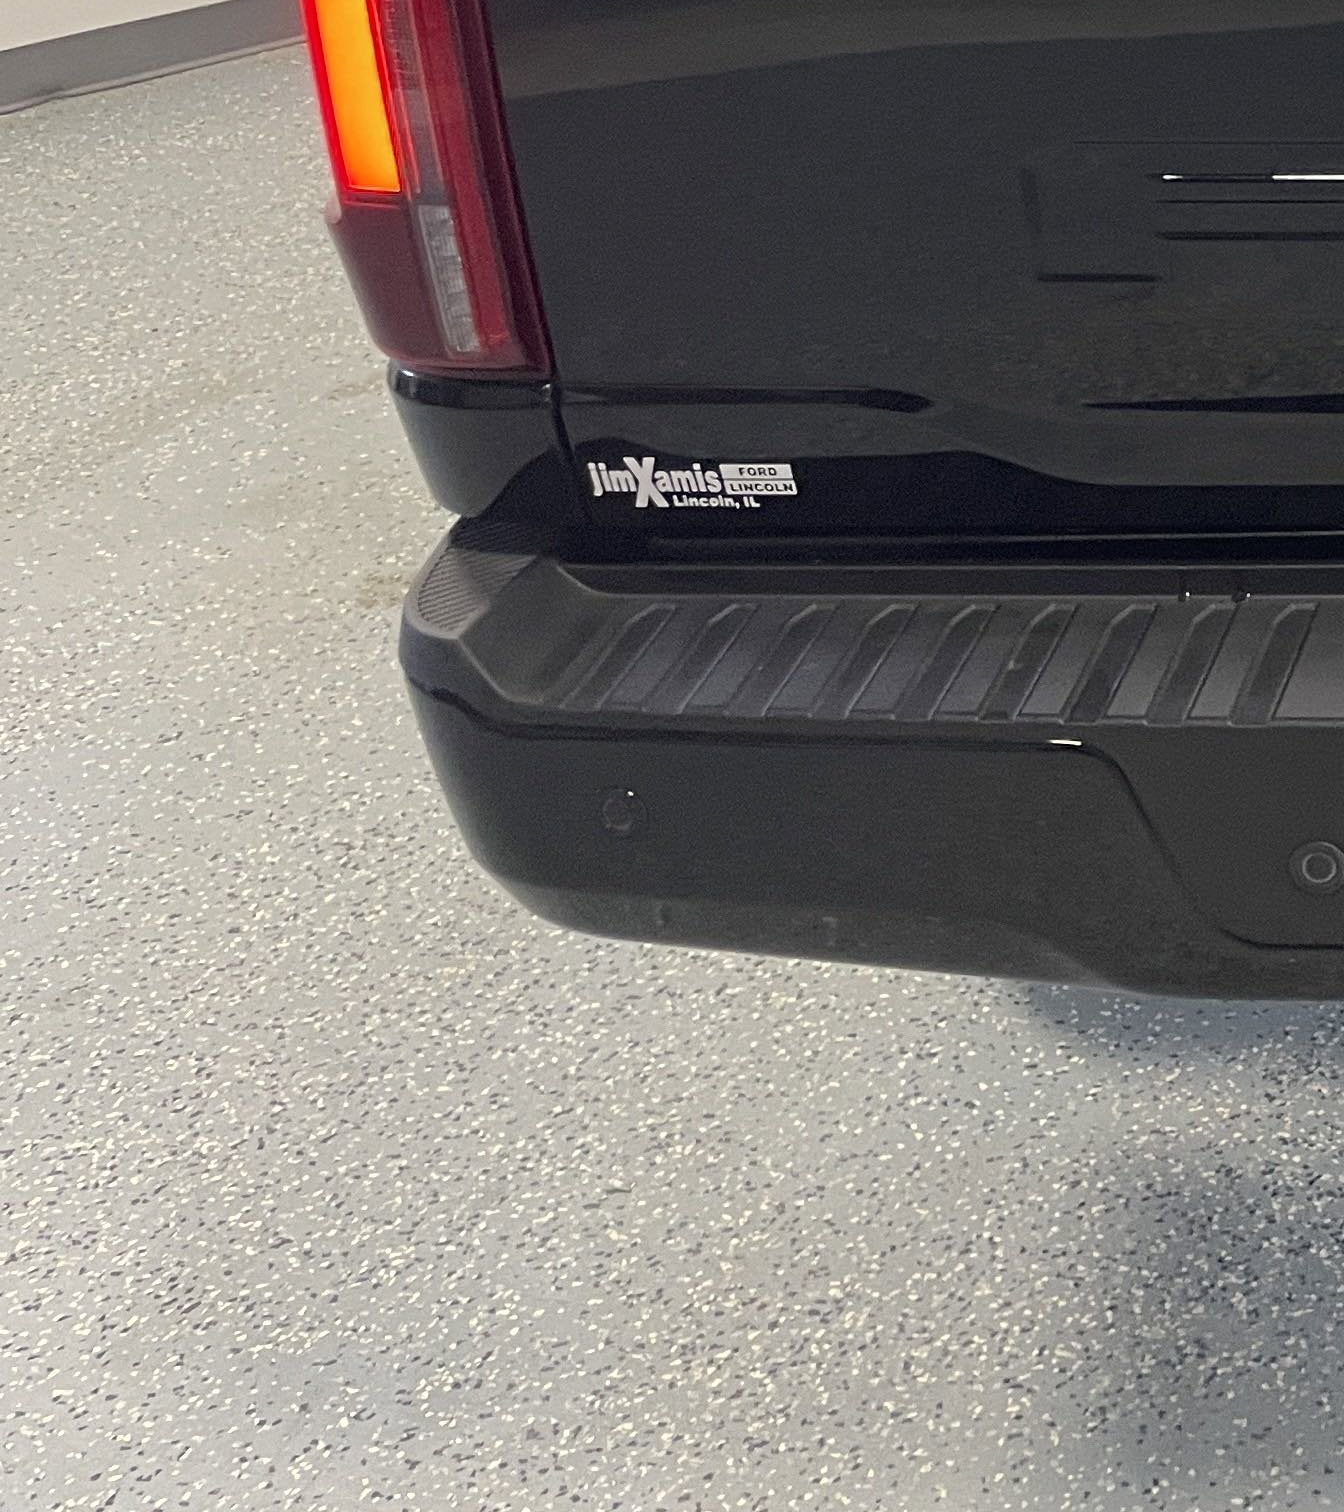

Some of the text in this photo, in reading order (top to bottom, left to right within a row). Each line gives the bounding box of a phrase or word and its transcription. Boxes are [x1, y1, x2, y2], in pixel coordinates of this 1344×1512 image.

[738, 466, 778, 477] FORD
[729, 482, 794, 493] LINCOLN
[672, 494, 761, 509] Lincoln, IL
